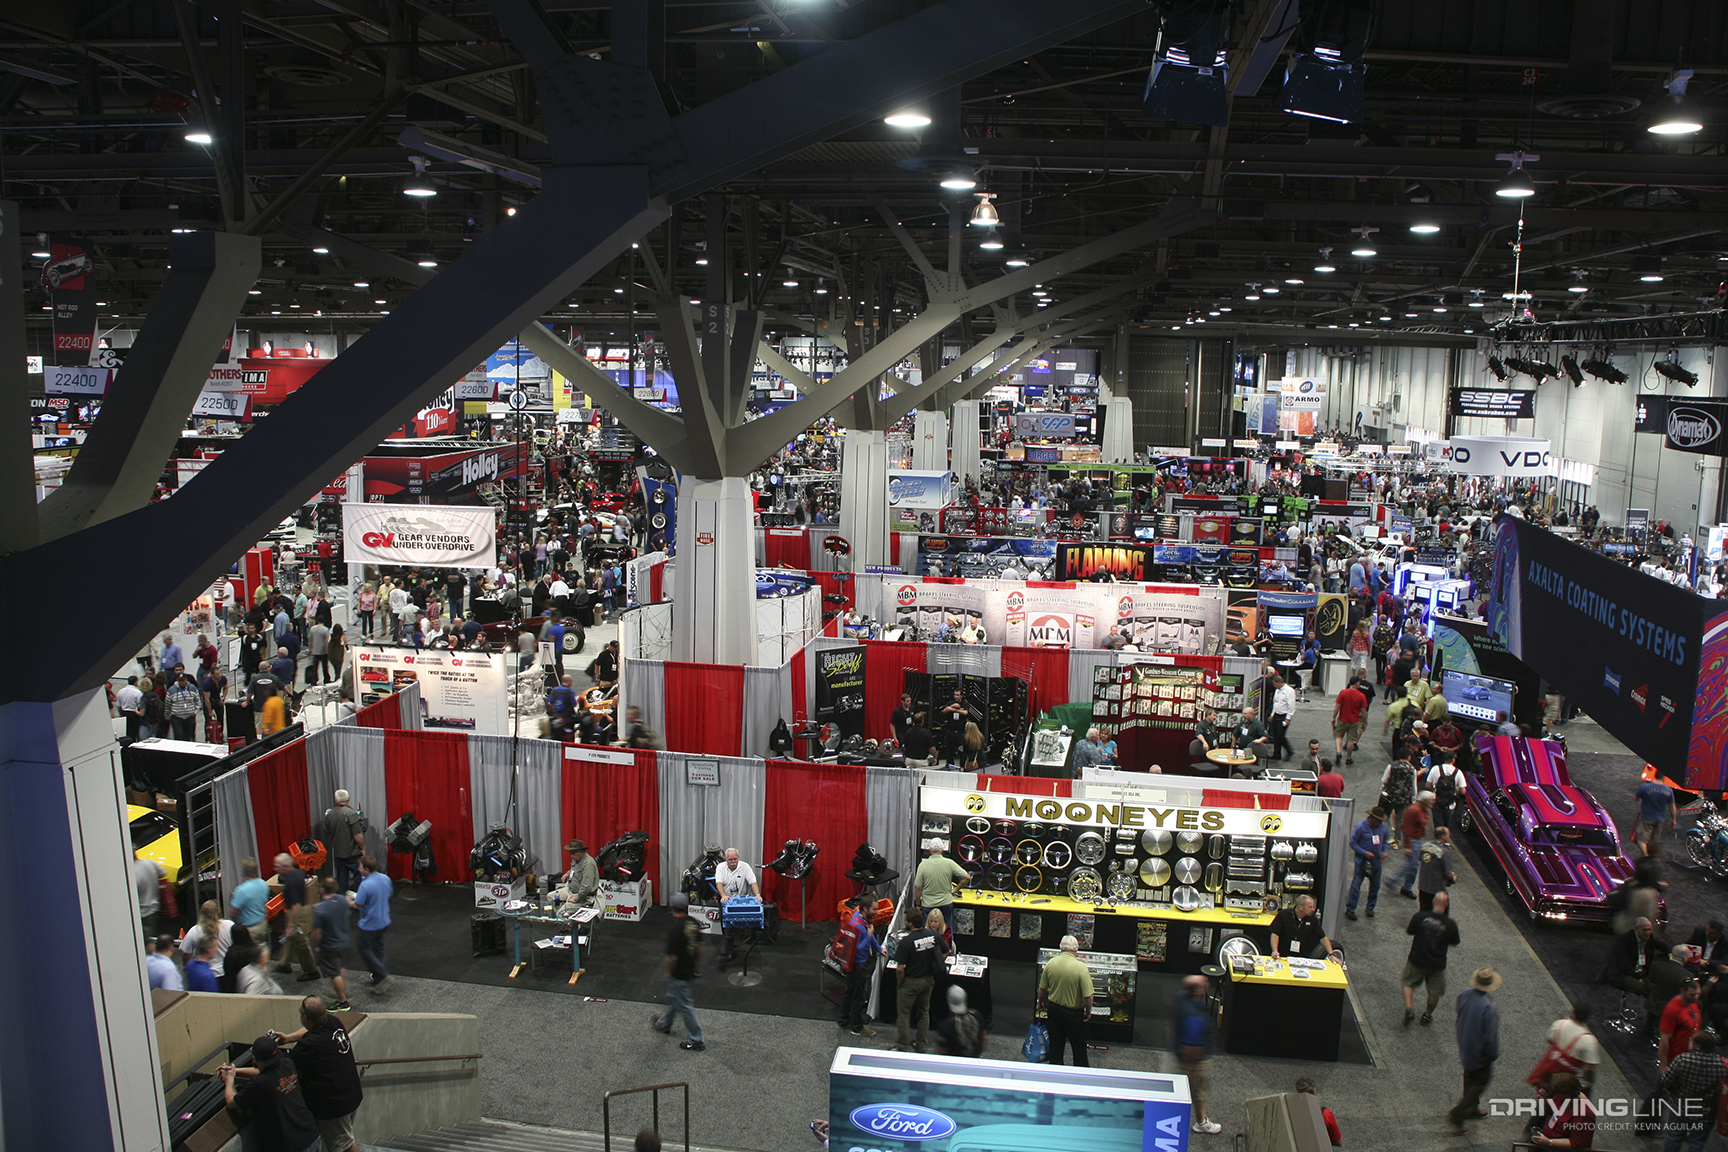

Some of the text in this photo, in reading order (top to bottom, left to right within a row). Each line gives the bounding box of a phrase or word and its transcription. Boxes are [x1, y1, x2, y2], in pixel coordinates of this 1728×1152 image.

[709, 305, 718, 334] S 2
[58, 336, 90, 349] 22400
[864, 327, 870, 345] S 3
[55, 373, 97, 387] 22400
[461, 385, 489, 394] 22600
[201, 397, 238, 411] 22500
[1459, 391, 1525, 404] SSBC
[426, 412, 439, 430] 110
[1670, 412, 1709, 441] Dynamat
[462, 452, 499, 486] Holley
[893, 487, 926, 499] TIRE
[362, 532, 470, 548] GV GEAR VENDORS
[392, 541, 475, 551] UNDER OVERDRIVE
[1065, 546, 1146, 581] FLAMING
[896, 591, 917, 600] MBM
[1006, 597, 1024, 606] MBM
[1119, 602, 1133, 610] MBM
[1528, 560, 1686, 666] AXALTA COATING SYSTEMS
[1473, 634, 1491, 643] Where
[359, 653, 371, 662] GV
[404, 655, 415, 664] GV
[452, 658, 463, 667] GV
[826, 653, 863, 678] Stuff
[830, 680, 863, 689] manufacturer
[1005, 796, 1226, 831] MOONEYES
[494, 887, 507, 896] STP
[871, 1108, 935, 1135] Ford
